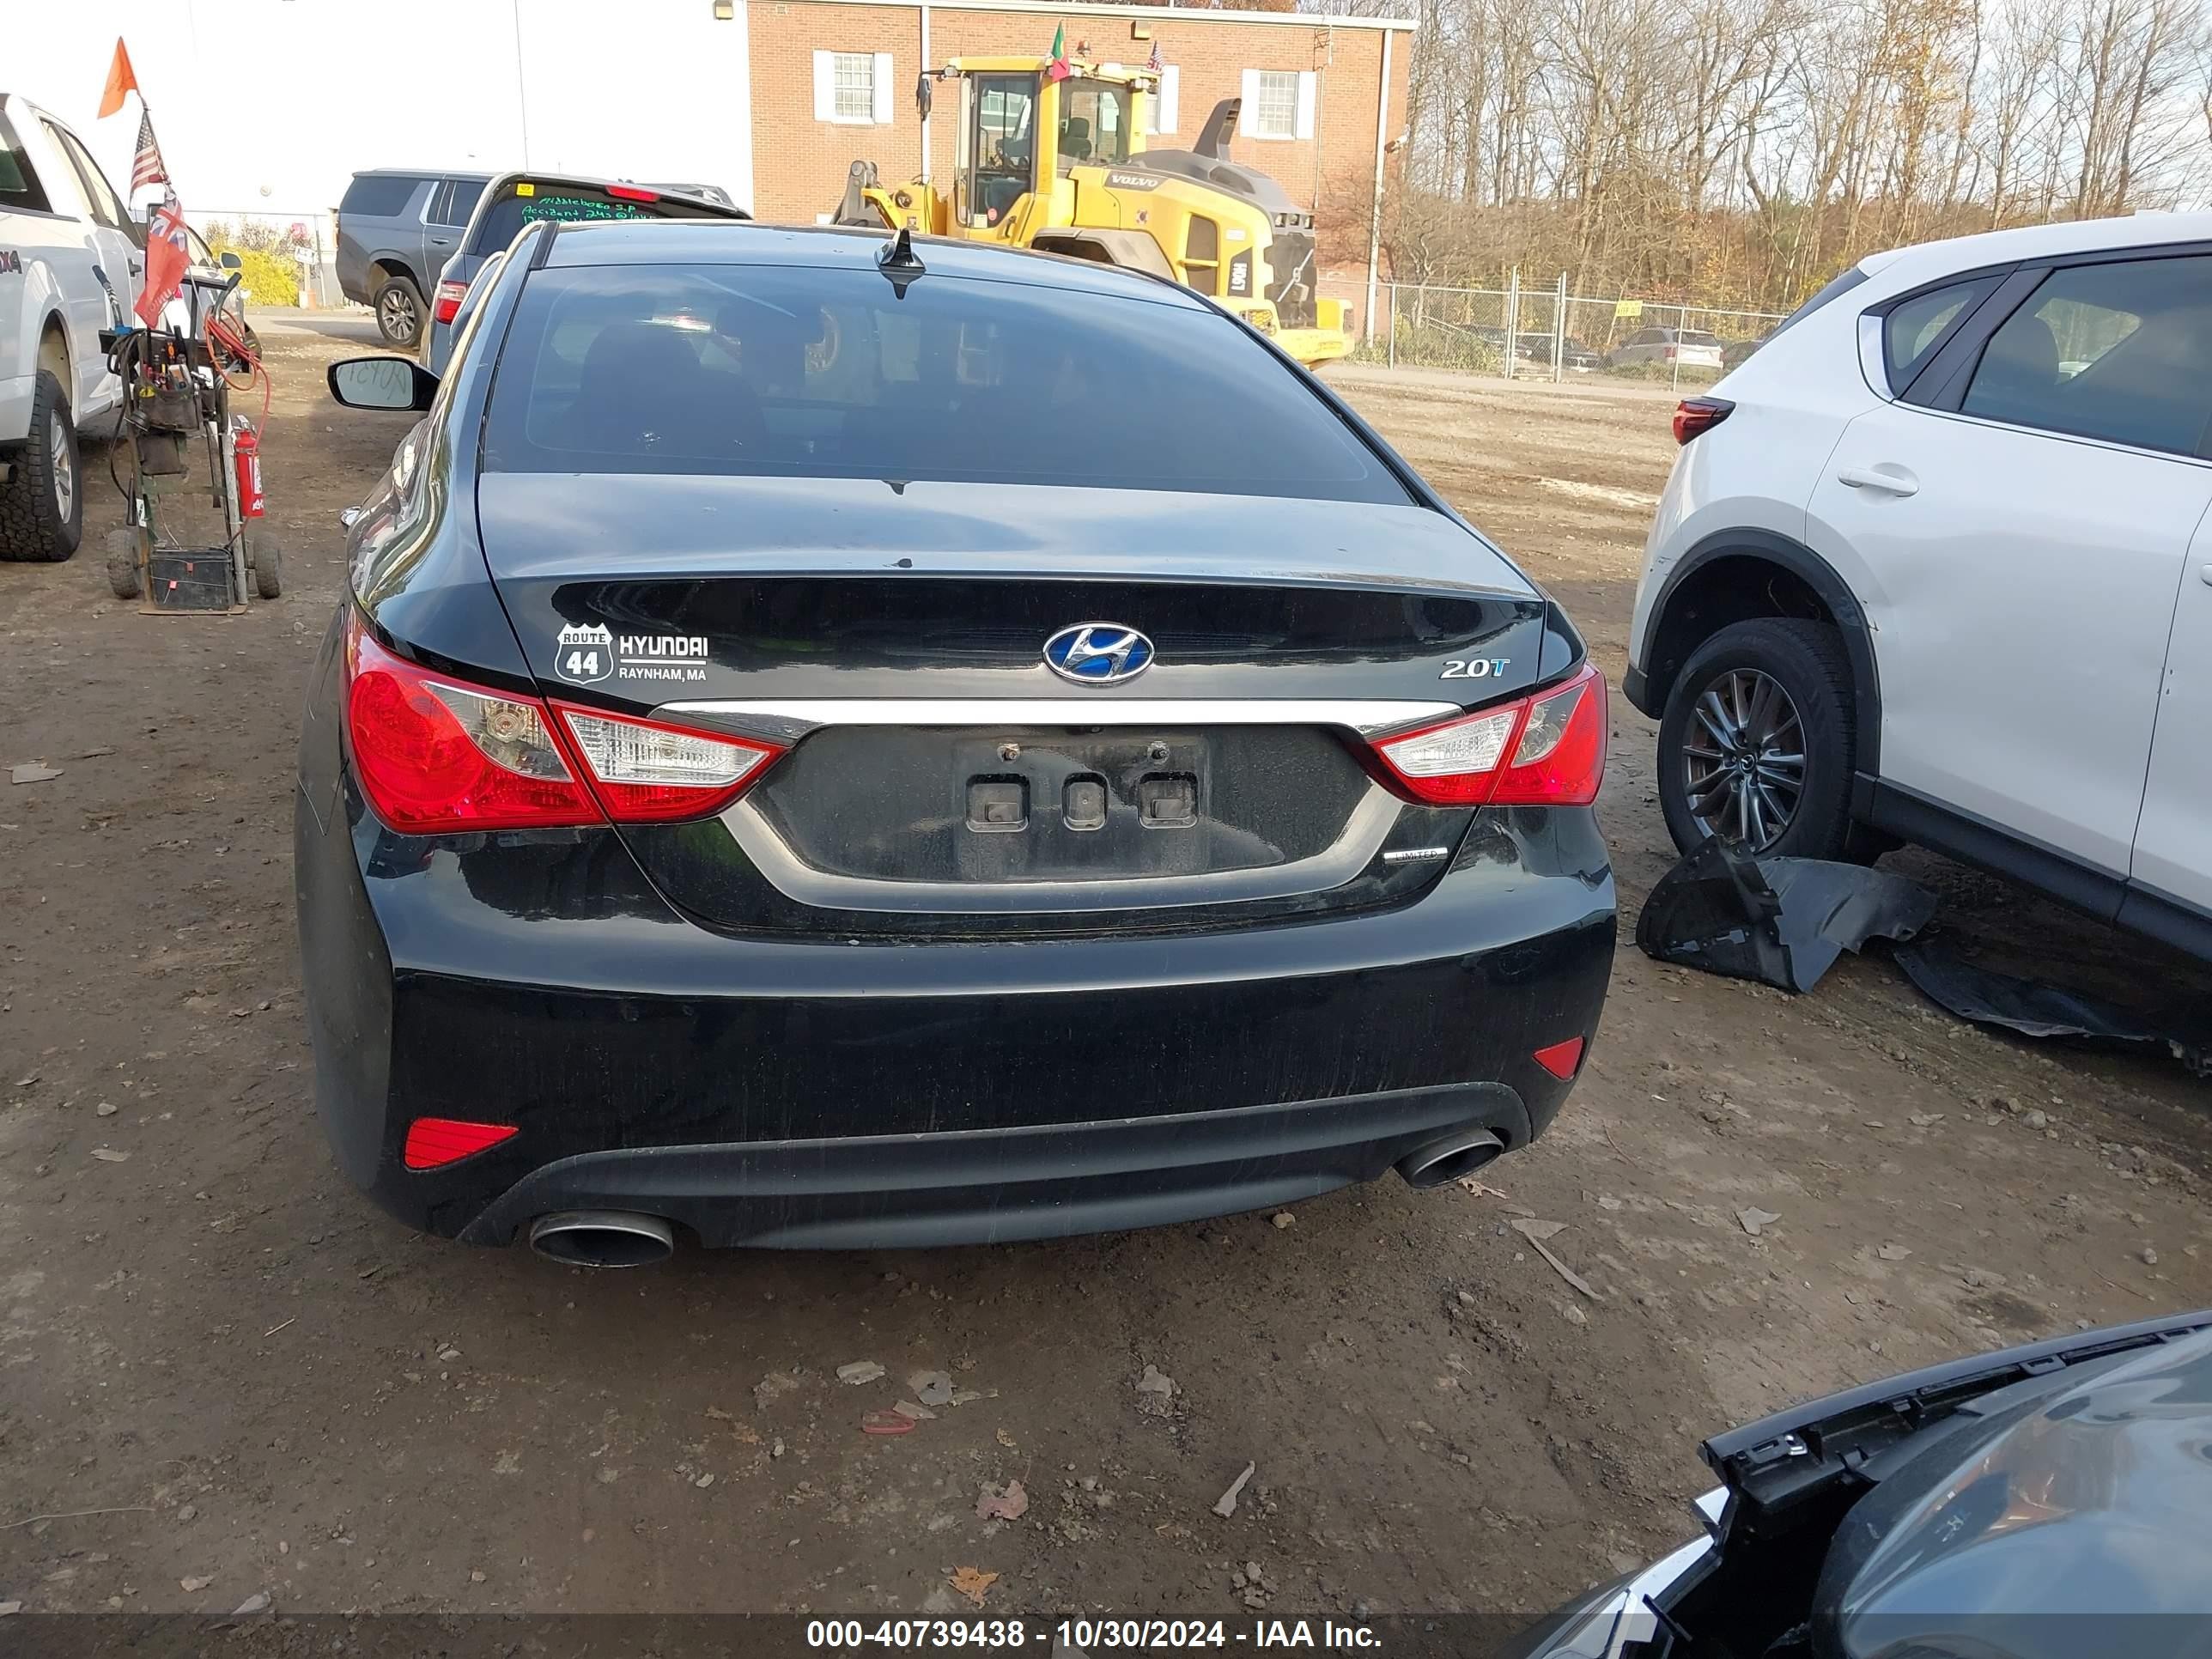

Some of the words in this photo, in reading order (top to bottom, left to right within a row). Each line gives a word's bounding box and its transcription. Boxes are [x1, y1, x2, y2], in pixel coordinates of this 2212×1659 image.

[1111, 174, 1158, 187] VOLVO
[0, 250, 22, 274] X4
[1231, 262, 1248, 290] L90H
[563, 633, 606, 643] ROUTE
[618, 635, 708, 657] HYUNDAI
[566, 651, 599, 675] 44
[1395, 850, 1437, 861] LIMITED
